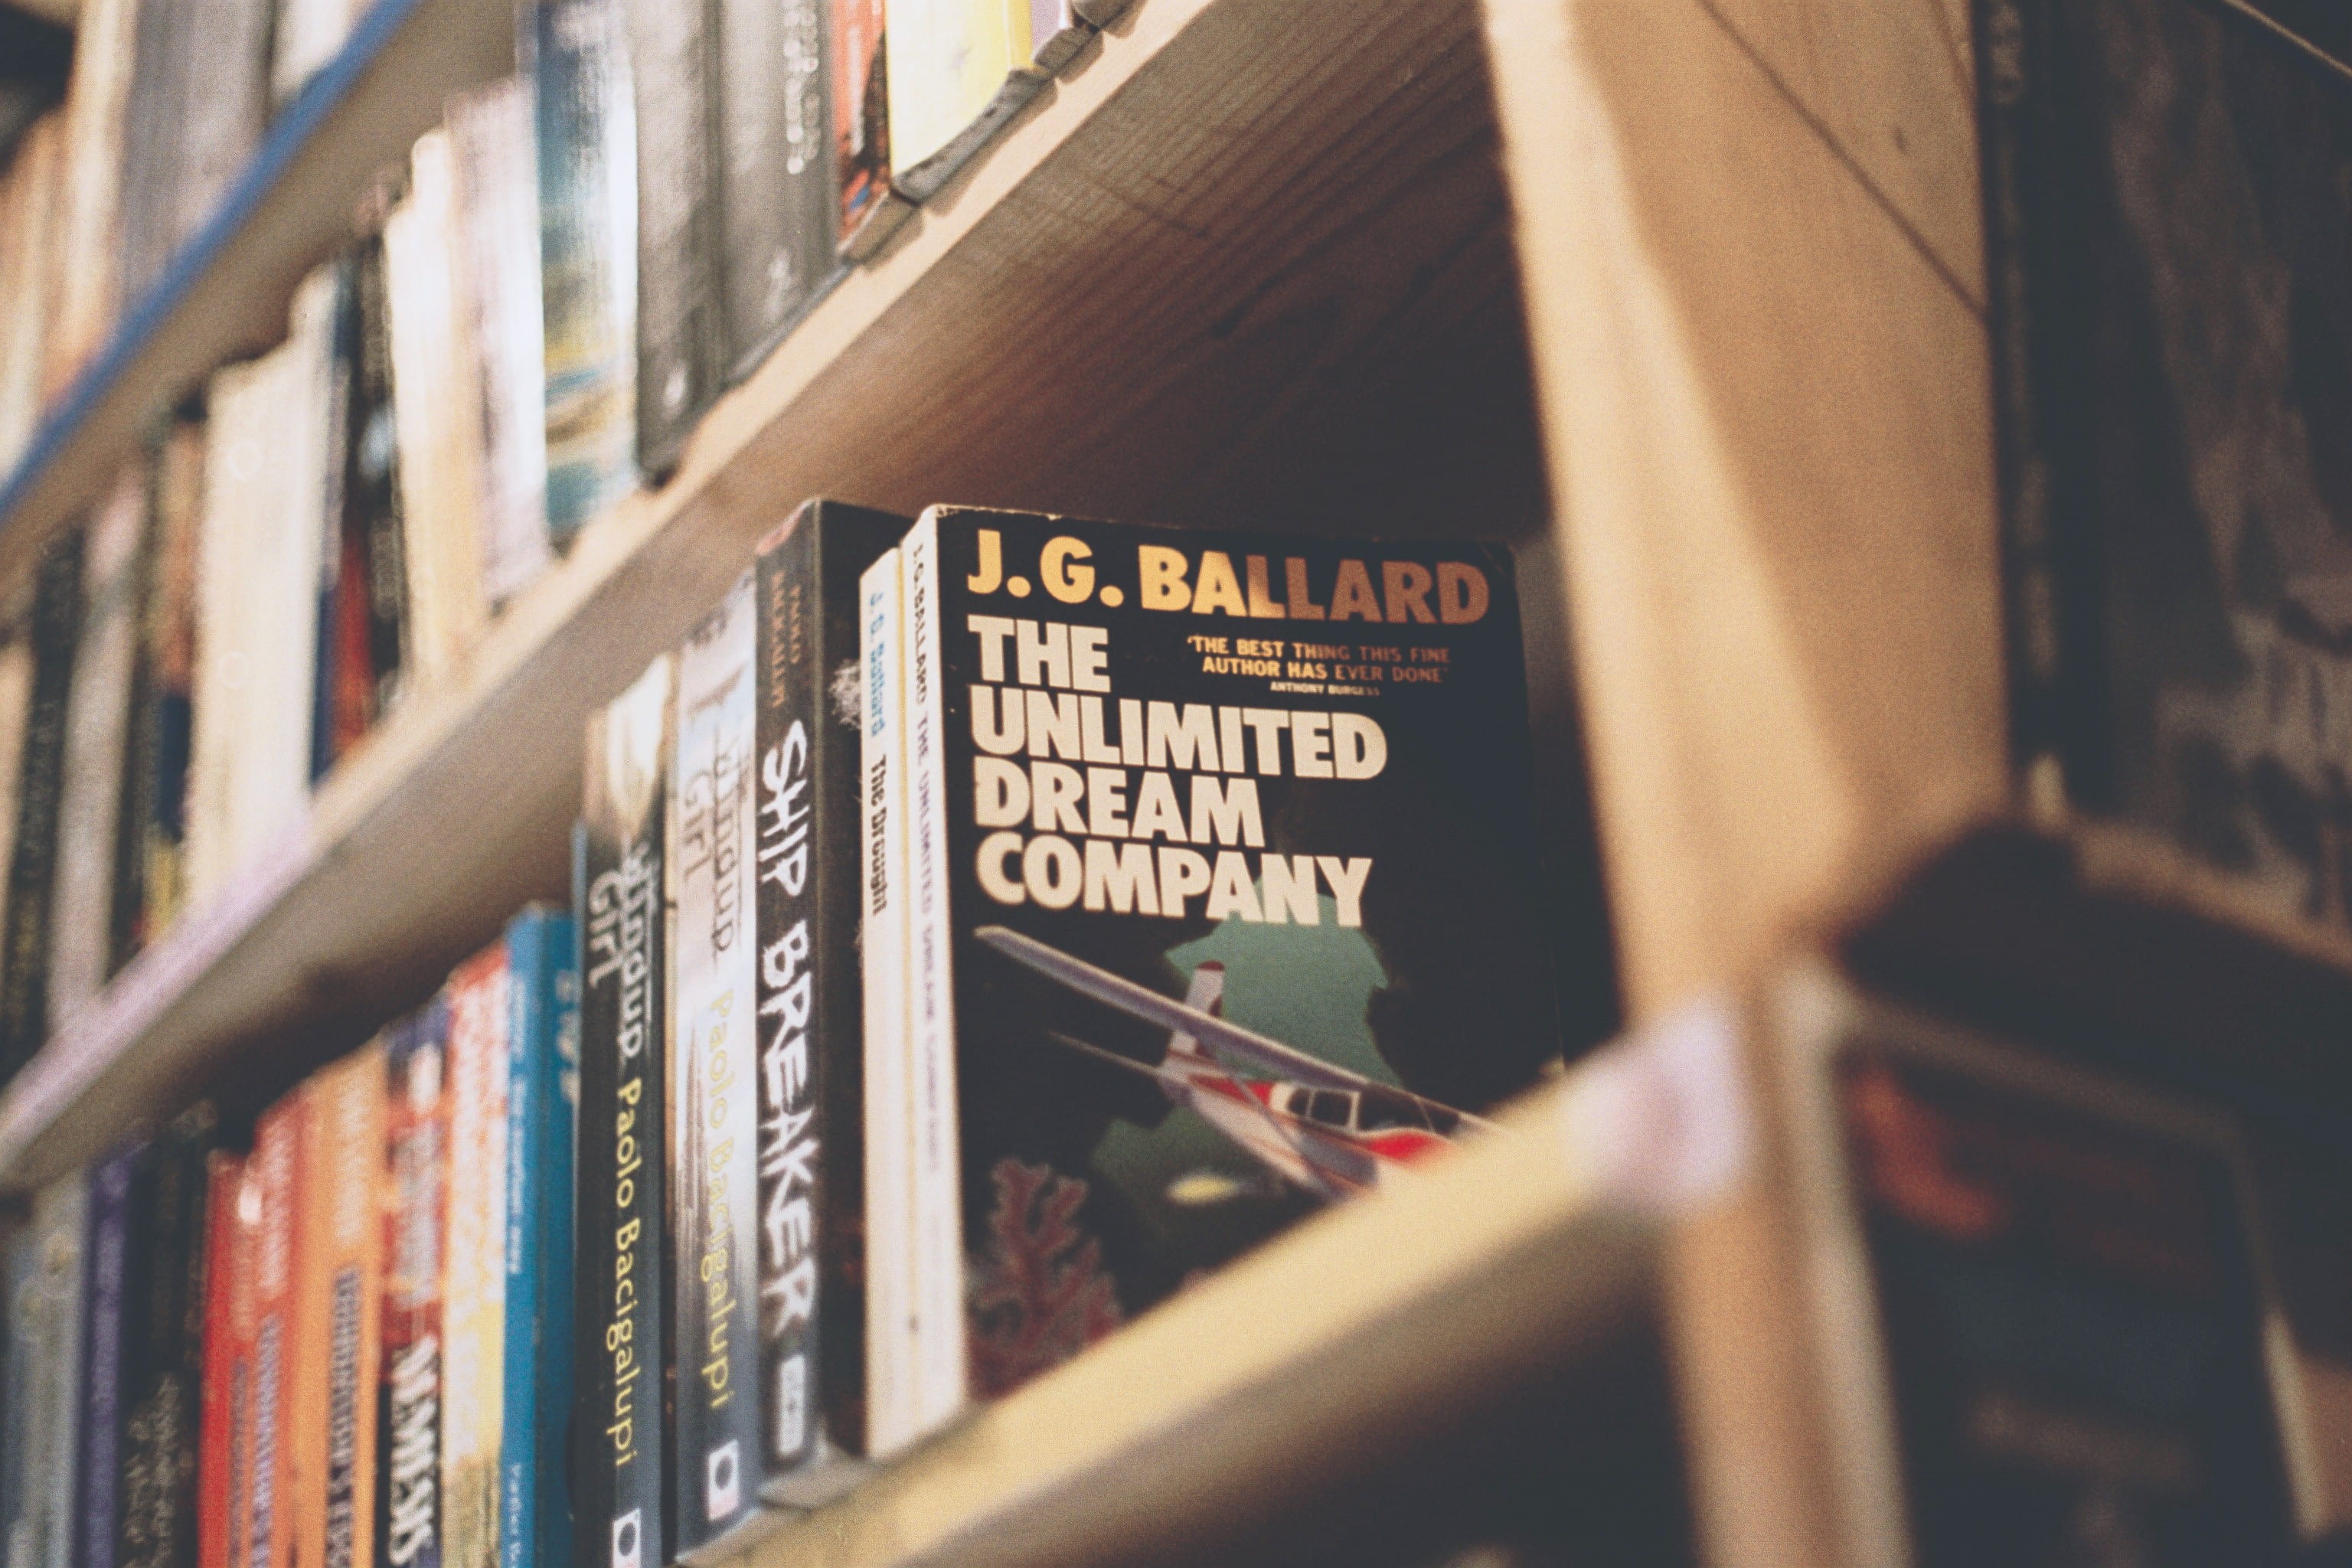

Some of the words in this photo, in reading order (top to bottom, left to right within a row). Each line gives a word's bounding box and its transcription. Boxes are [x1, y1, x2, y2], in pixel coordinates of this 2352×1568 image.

[968, 528, 1124, 608] J.G.
[1138, 544, 1489, 626] BALLARD
[913, 587, 928, 706] BALLARD
[968, 614, 1111, 692] THE
[1202, 656, 1281, 678] AUTHOR
[1287, 660, 1328, 680] HAS
[1334, 663, 1383, 682] EVER
[1236, 638, 1285, 658] BEST
[1291, 642, 1351, 661] THING
[1359, 645, 1403, 663] THIS
[1410, 647, 1451, 664] FINE
[871, 754, 887, 805] The
[970, 685, 1387, 779] UNLIMITED
[759, 719, 813, 898] SHIP
[973, 756, 1265, 848] DREAM
[871, 805, 889, 917] Drought
[975, 831, 1373, 927] COMPANY
[587, 869, 625, 990] Girl
[707, 989, 736, 1132] Paolo
[616, 1077, 642, 1209] Paolo
[759, 923, 819, 1334] BREAKER
[700, 1133, 738, 1410] Bacigalupi
[606, 1216, 642, 1468] Bacigalupi
